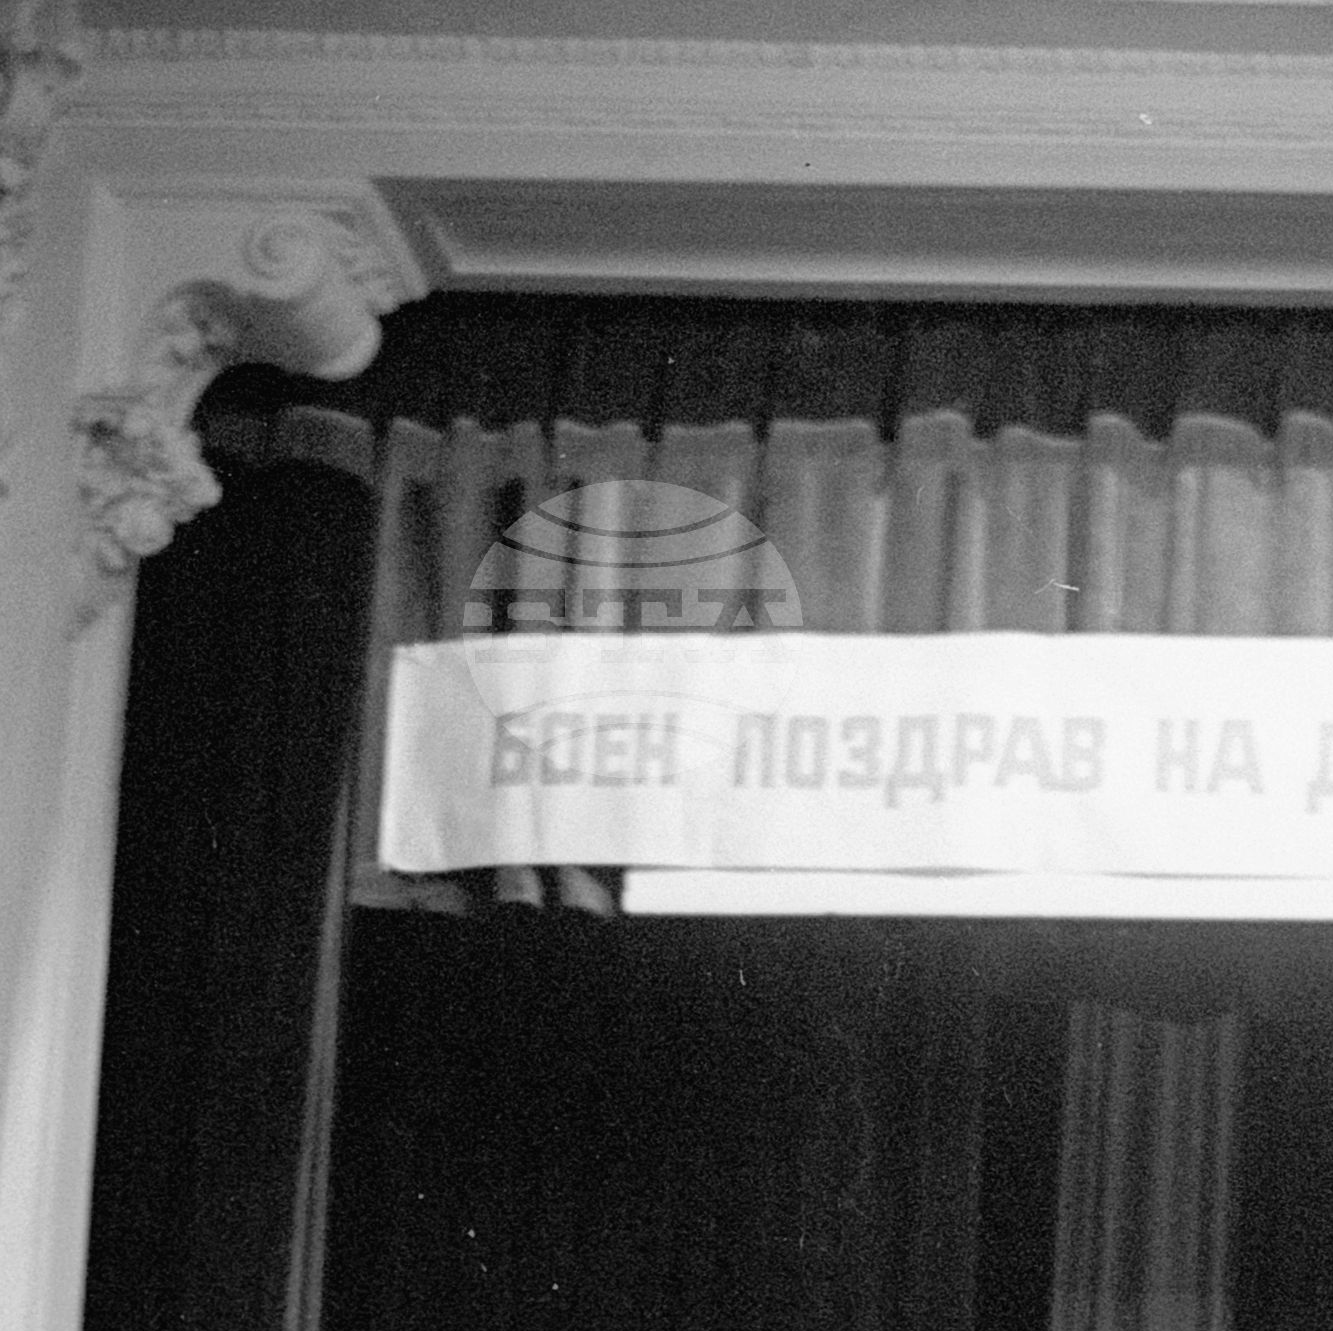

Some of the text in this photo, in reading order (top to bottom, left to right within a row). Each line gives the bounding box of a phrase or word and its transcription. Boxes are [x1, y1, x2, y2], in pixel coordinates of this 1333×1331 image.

[490, 711, 679, 788] БОЕН
[732, 712, 1107, 808] ПОЗДРАВ
[1155, 717, 1265, 794] НА
